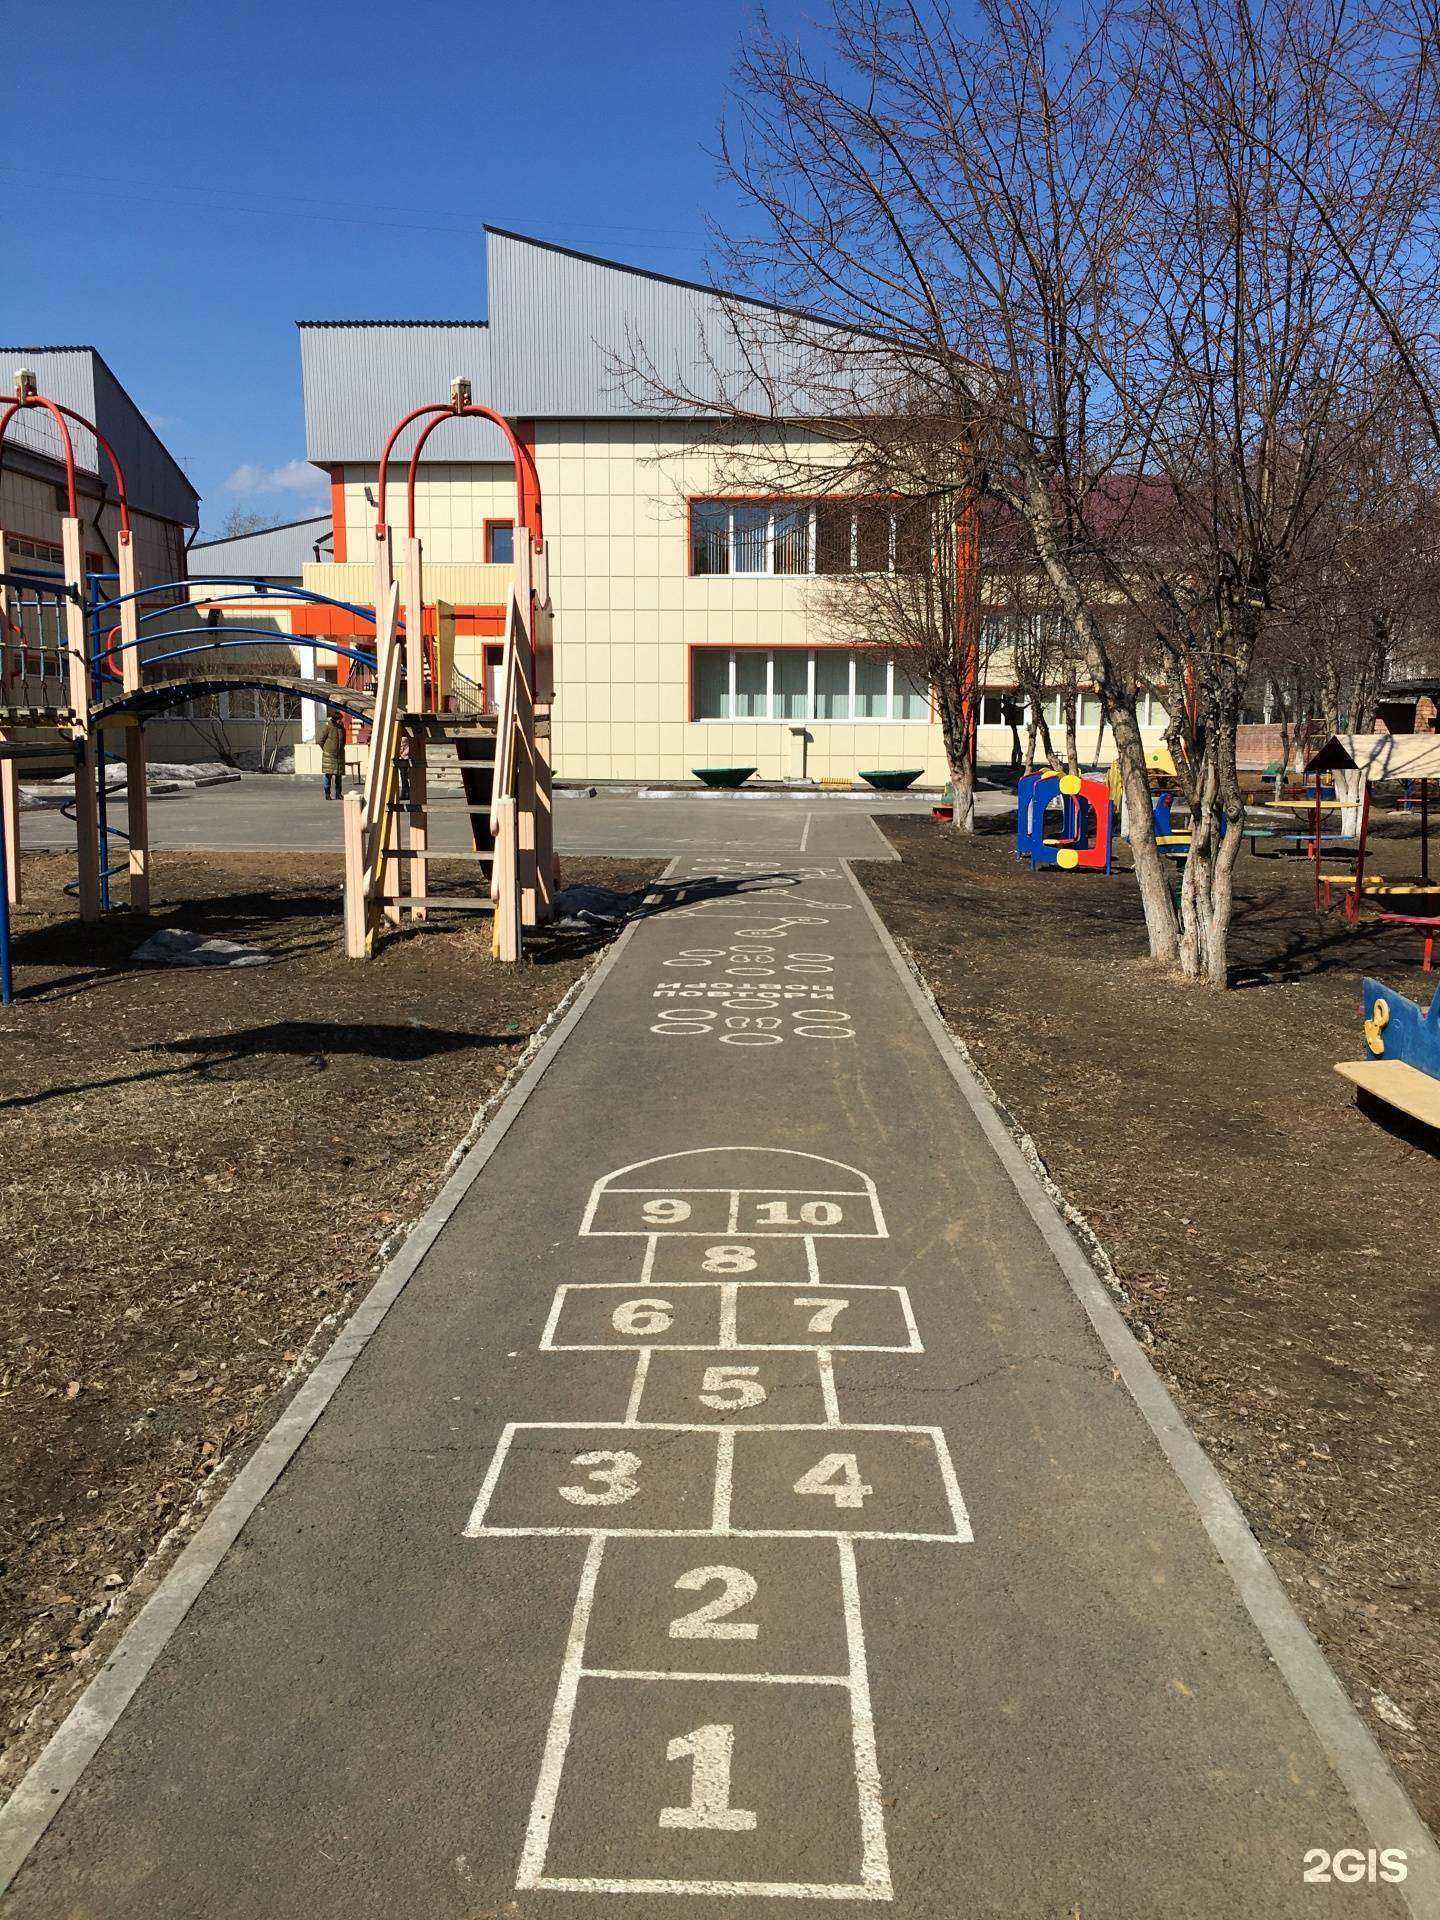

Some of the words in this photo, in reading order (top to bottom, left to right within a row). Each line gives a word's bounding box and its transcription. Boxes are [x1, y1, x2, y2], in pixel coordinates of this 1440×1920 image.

[652, 990, 835, 1000] ПОВТОРИ
[641, 1198, 692, 1225] 9
[756, 1200, 843, 1226] 10
[701, 1245, 758, 1274] 8
[611, 1298, 674, 1336] 6
[793, 1297, 850, 1333] 7
[698, 1365, 767, 1411] 5
[558, 1449, 643, 1506] 3
[792, 1452, 873, 1508] 4
[668, 1564, 760, 1640] 2
[658, 1723, 758, 1832] 1
